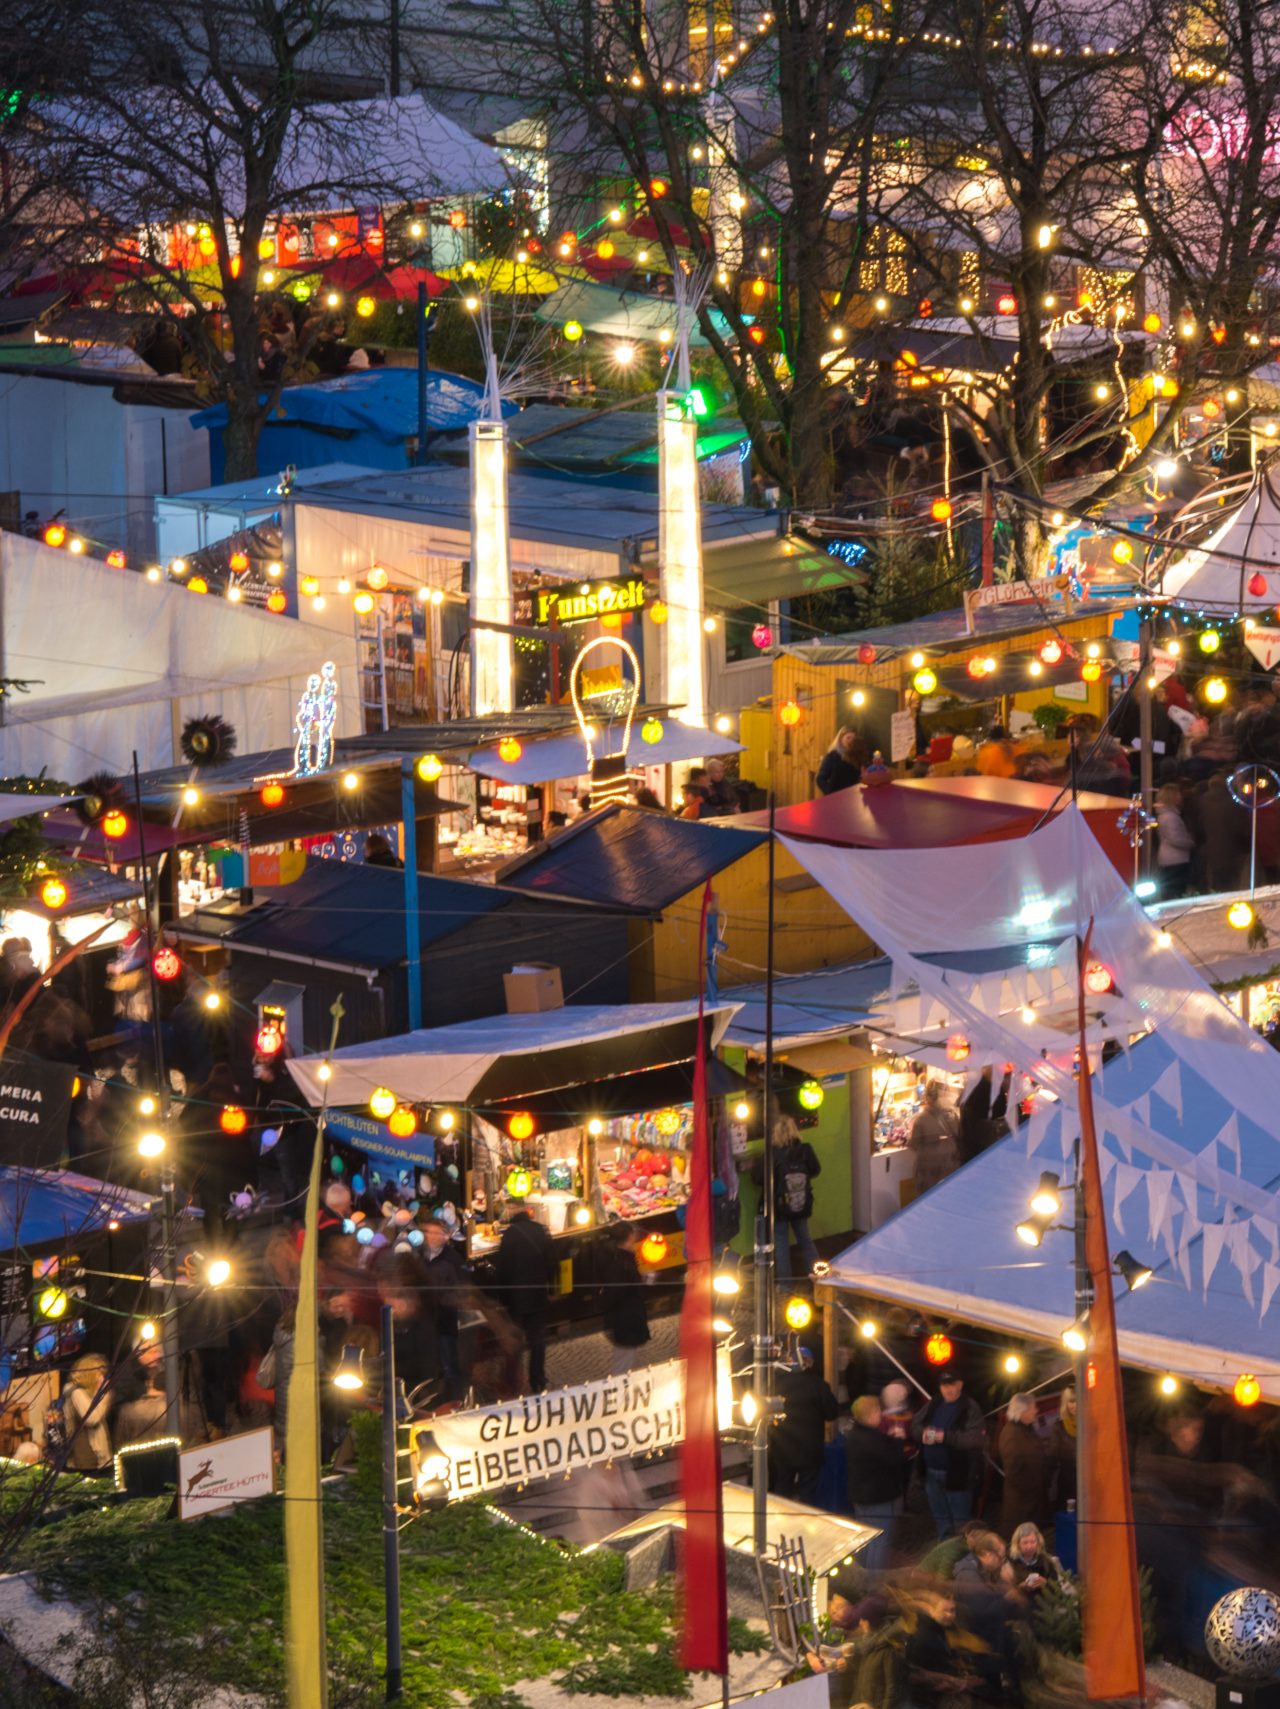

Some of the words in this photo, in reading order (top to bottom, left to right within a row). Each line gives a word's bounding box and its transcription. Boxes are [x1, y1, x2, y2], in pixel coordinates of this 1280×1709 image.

[538, 580, 646, 623] Kunstzelt
[0, 1085, 42, 1102] MERA
[0, 1107, 40, 1125] CURA
[325, 1109, 379, 1136] LICHTBLÜTEN
